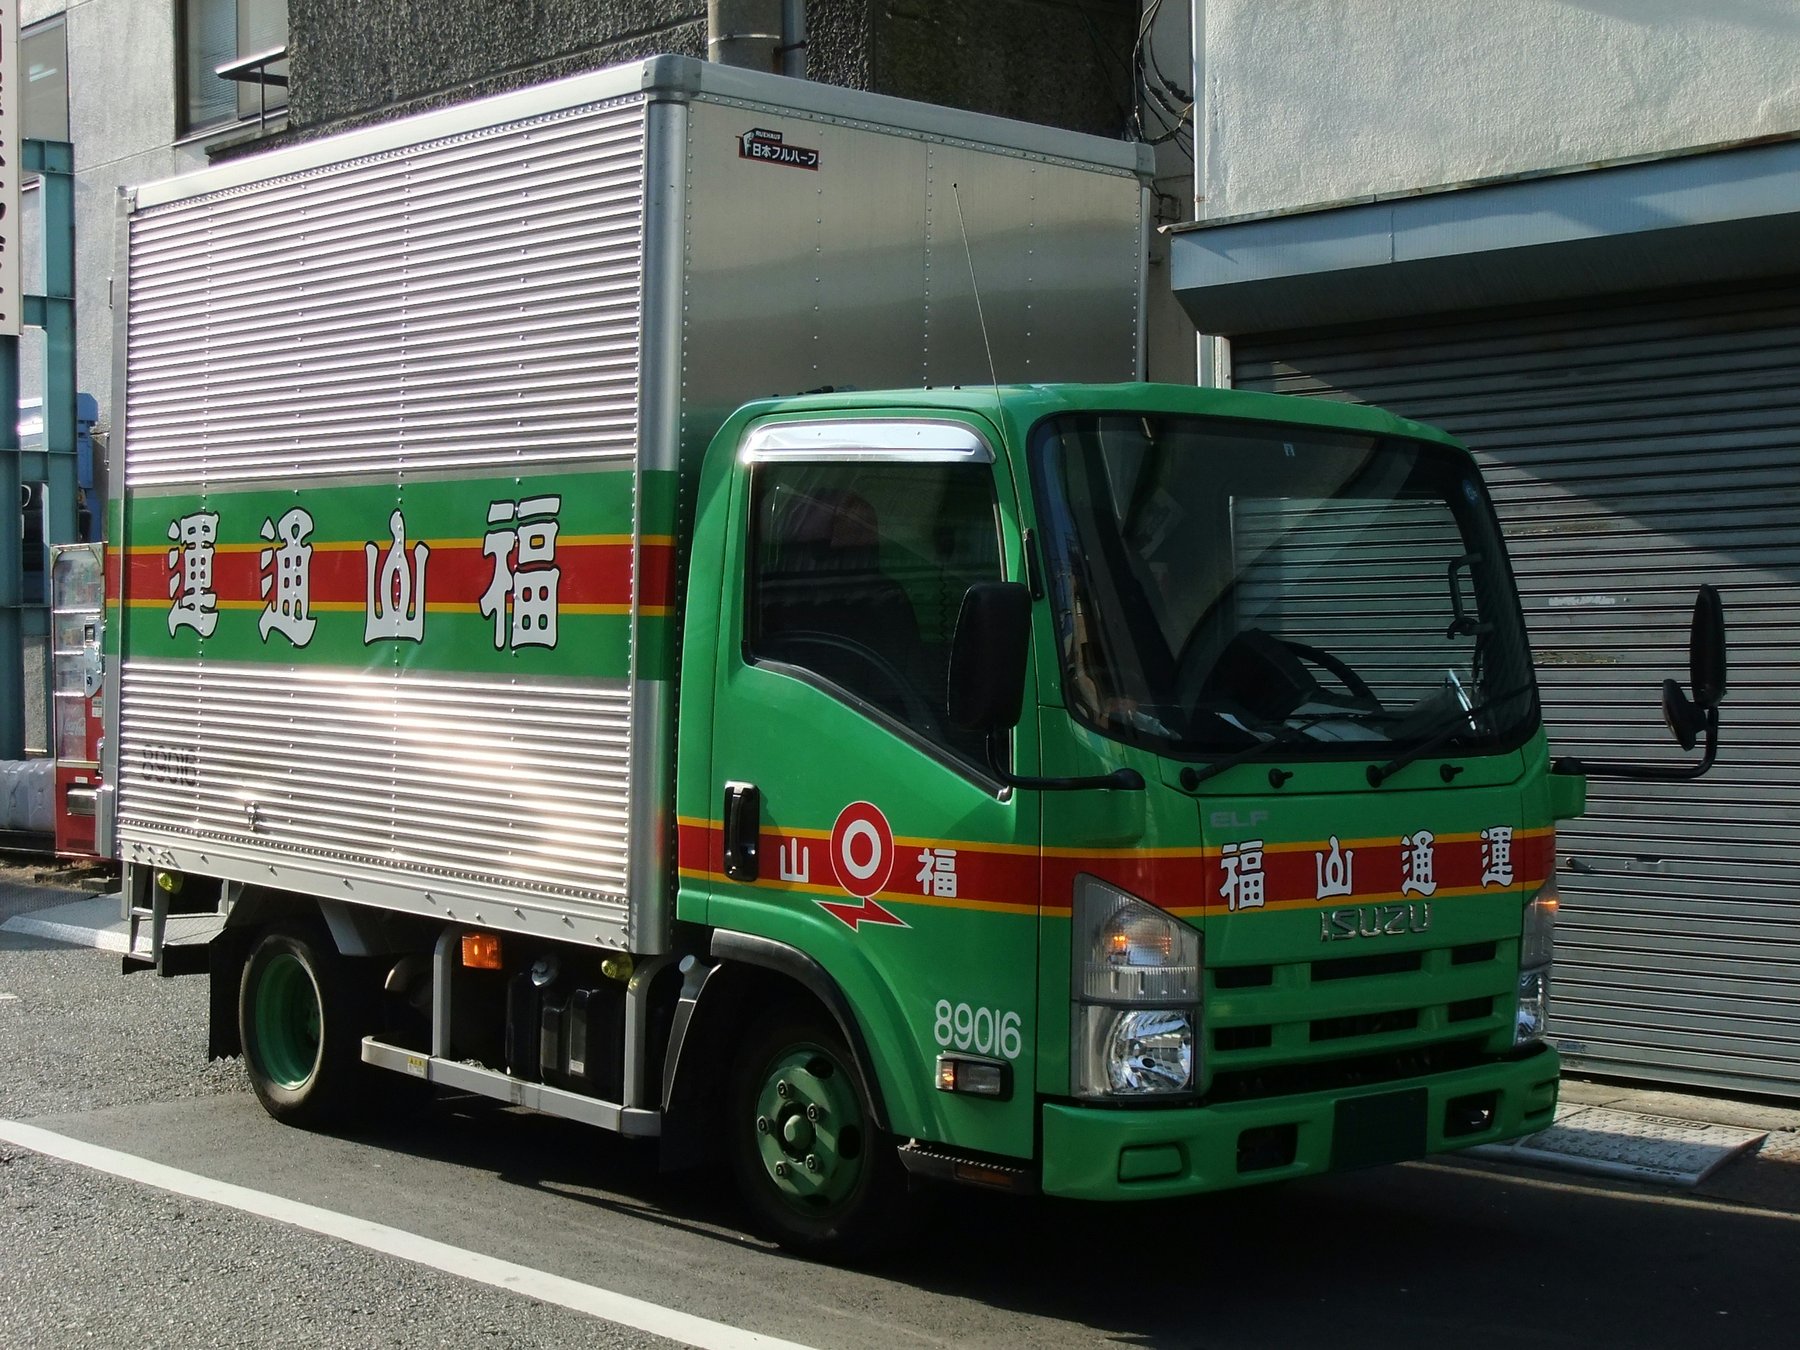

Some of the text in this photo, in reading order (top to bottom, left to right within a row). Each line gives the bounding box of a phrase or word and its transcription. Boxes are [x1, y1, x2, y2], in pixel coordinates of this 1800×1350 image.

[753, 143, 817, 165] 日本フルハーフ
[1209, 811, 1269, 828] ELF
[779, 838, 957, 898] 山 福
[1320, 902, 1432, 942] ISUZU
[934, 999, 1022, 1059] 89016
